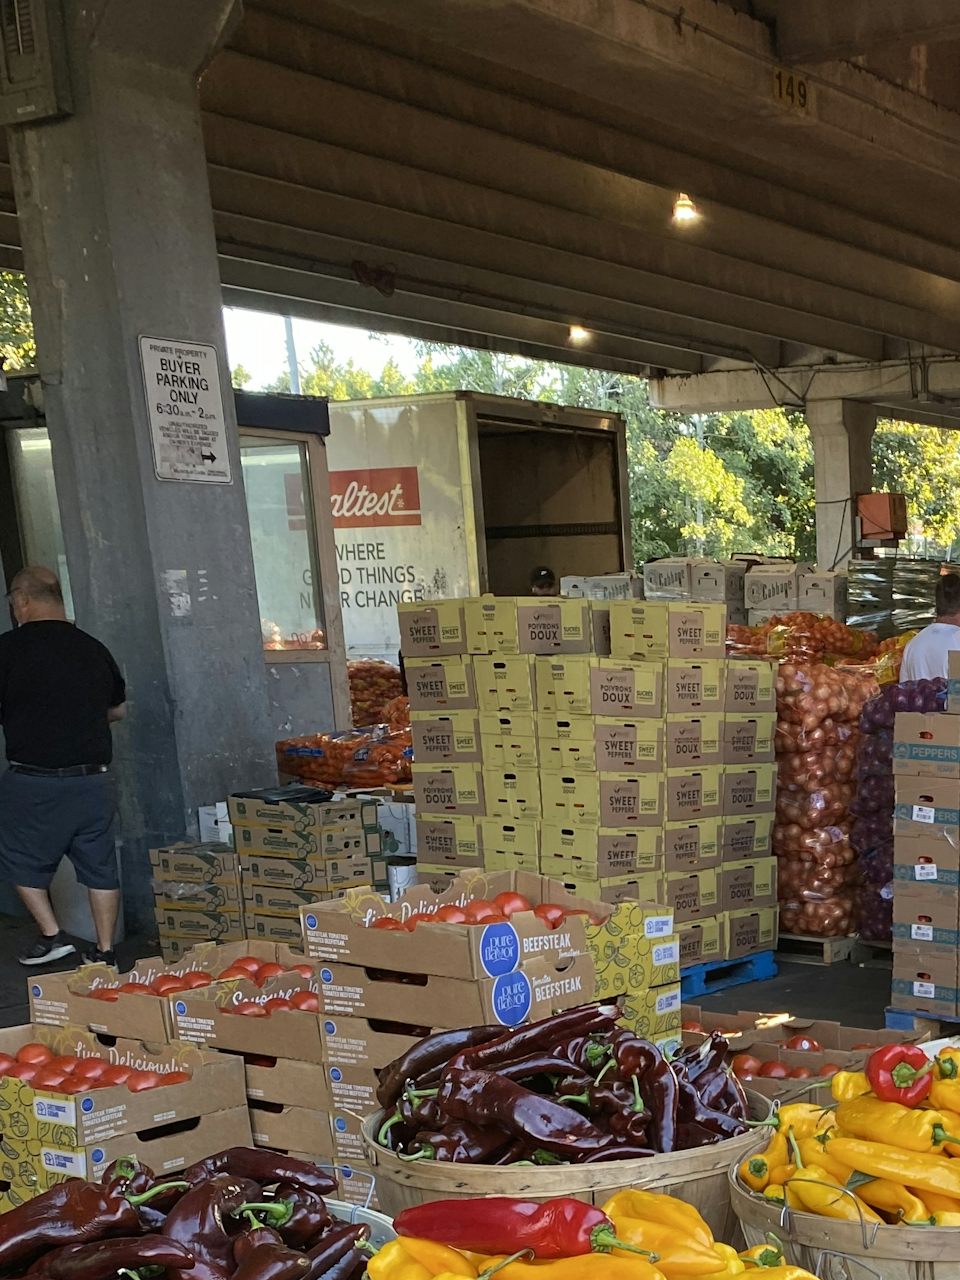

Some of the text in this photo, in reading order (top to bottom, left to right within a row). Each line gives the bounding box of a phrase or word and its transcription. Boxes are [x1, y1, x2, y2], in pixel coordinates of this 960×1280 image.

[775, 70, 807, 108] 149
[149, 344, 207, 359] PRIVATE PROPERTY
[160, 358, 201, 375] BUYER
[156, 373, 209, 391] PARKING
[169, 389, 198, 404] ONLY
[330, 481, 420, 518] altest
[303, 565, 415, 586] GD THINGS
[762, 580, 793, 601] Cabbage
[409, 625, 437, 637] SWEET
[441, 628, 459, 636] SWEET
[530, 630, 558, 640] DOUX
[677, 627, 702, 638] SWEET
[679, 636, 700, 645] PEPPERS
[416, 680, 444, 691] SWEET
[600, 684, 632, 692] POIVRONS
[676, 683, 700, 692] SWEET
[602, 692, 630, 703] DOUX
[678, 692, 699, 700] PEPPERS
[734, 691, 754, 700] DOUX
[423, 735, 451, 745] SWEET
[731, 736, 754, 746] SWEET
[605, 741, 634, 751] SWEET
[676, 745, 698, 754] DOUX
[607, 751, 632, 759] PEPPERS
[911, 746, 957, 760] PEPPERS
[426, 795, 453, 804] DOUX
[609, 796, 637, 806] SWEET
[676, 790, 700, 801] SWEET
[732, 793, 752, 804] DOUX
[425, 836, 453, 846] SWEET
[674, 841, 698, 851] SWEET
[607, 850, 634, 860] SWEET
[731, 889, 751, 898] DOUX
[676, 901, 698, 911] DOUX
[489, 934, 514, 949] pure
[522, 933, 571, 953] BEEFSTEAK
[485, 945, 515, 963] flavor
[502, 981, 525, 997] pure
[535, 976, 582, 1002] BEEFSTEAK
[497, 992, 527, 1011] flavor
[108, 1047, 184, 1074] Deliciousl
